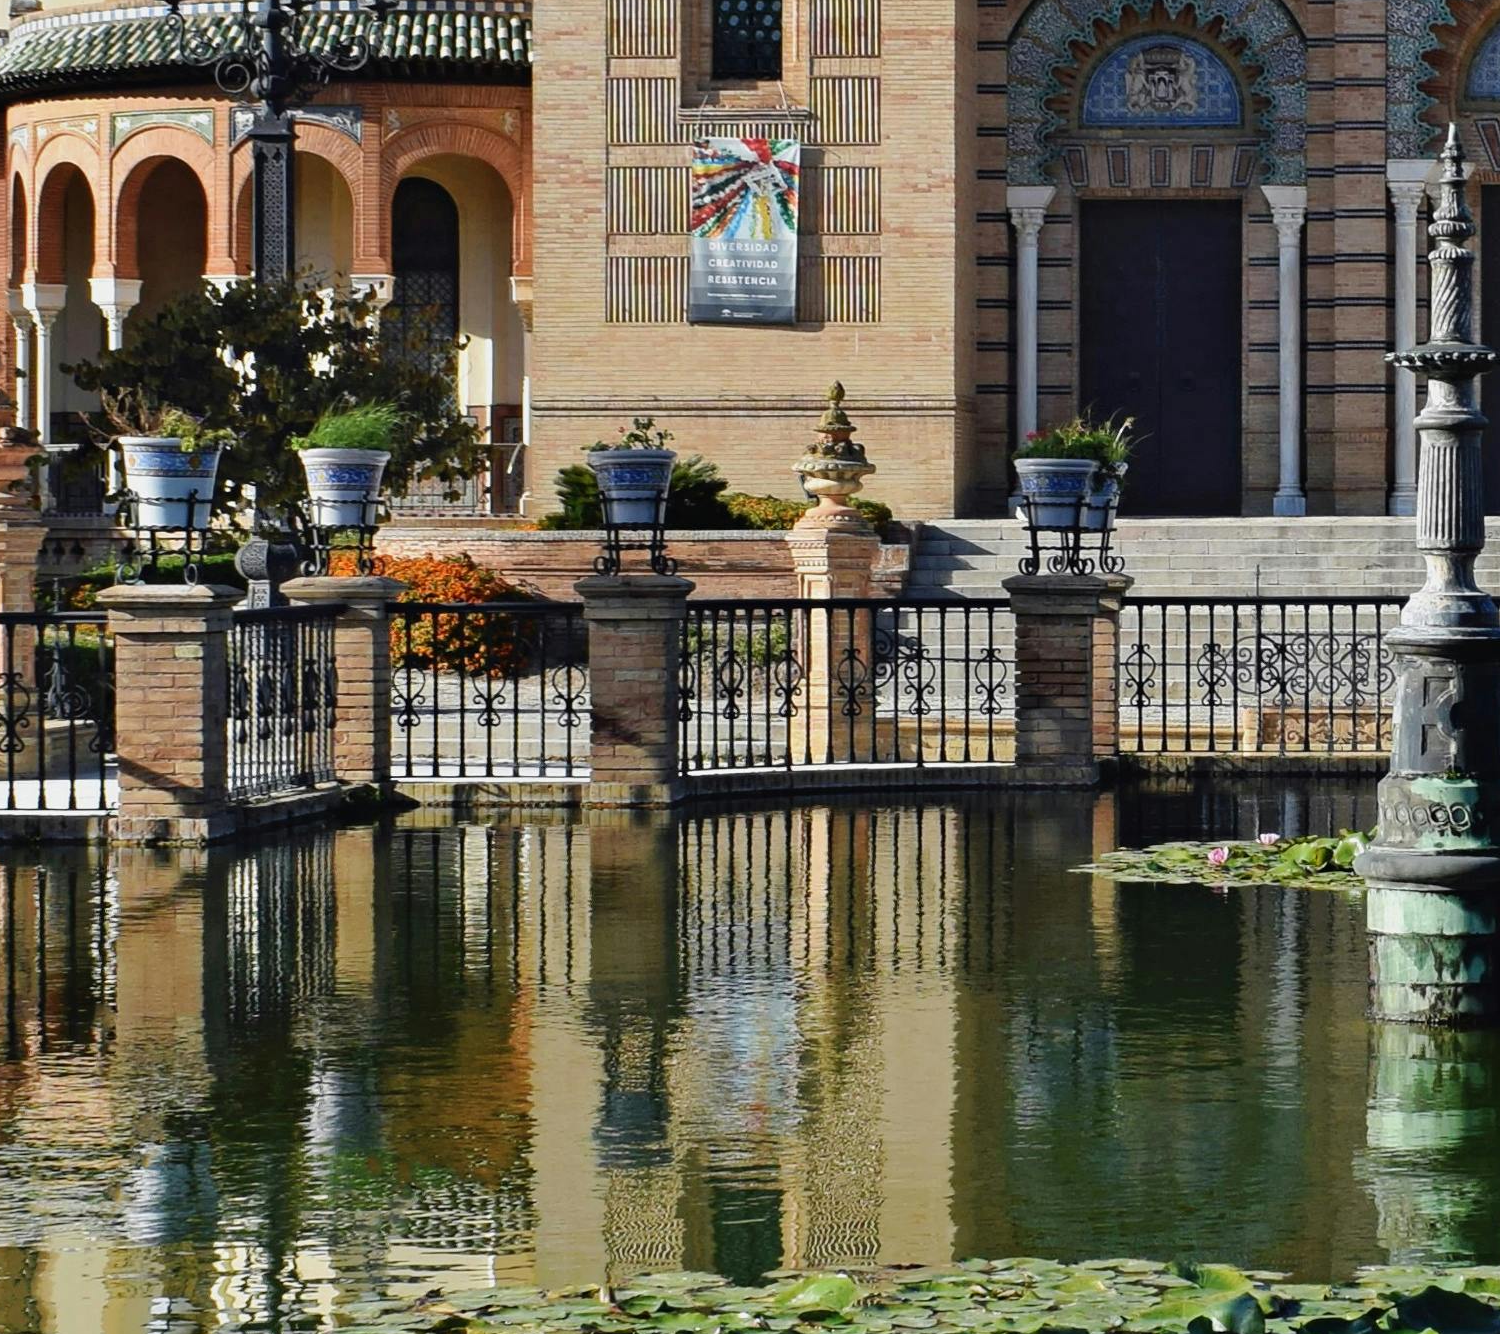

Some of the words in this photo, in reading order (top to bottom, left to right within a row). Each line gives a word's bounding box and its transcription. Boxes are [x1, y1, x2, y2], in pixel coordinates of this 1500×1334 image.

[708, 242, 778, 252] DIVERSIDAD
[708, 259, 778, 269] CREATIVIDAD
[707, 275, 777, 285] RESISTENCIA
